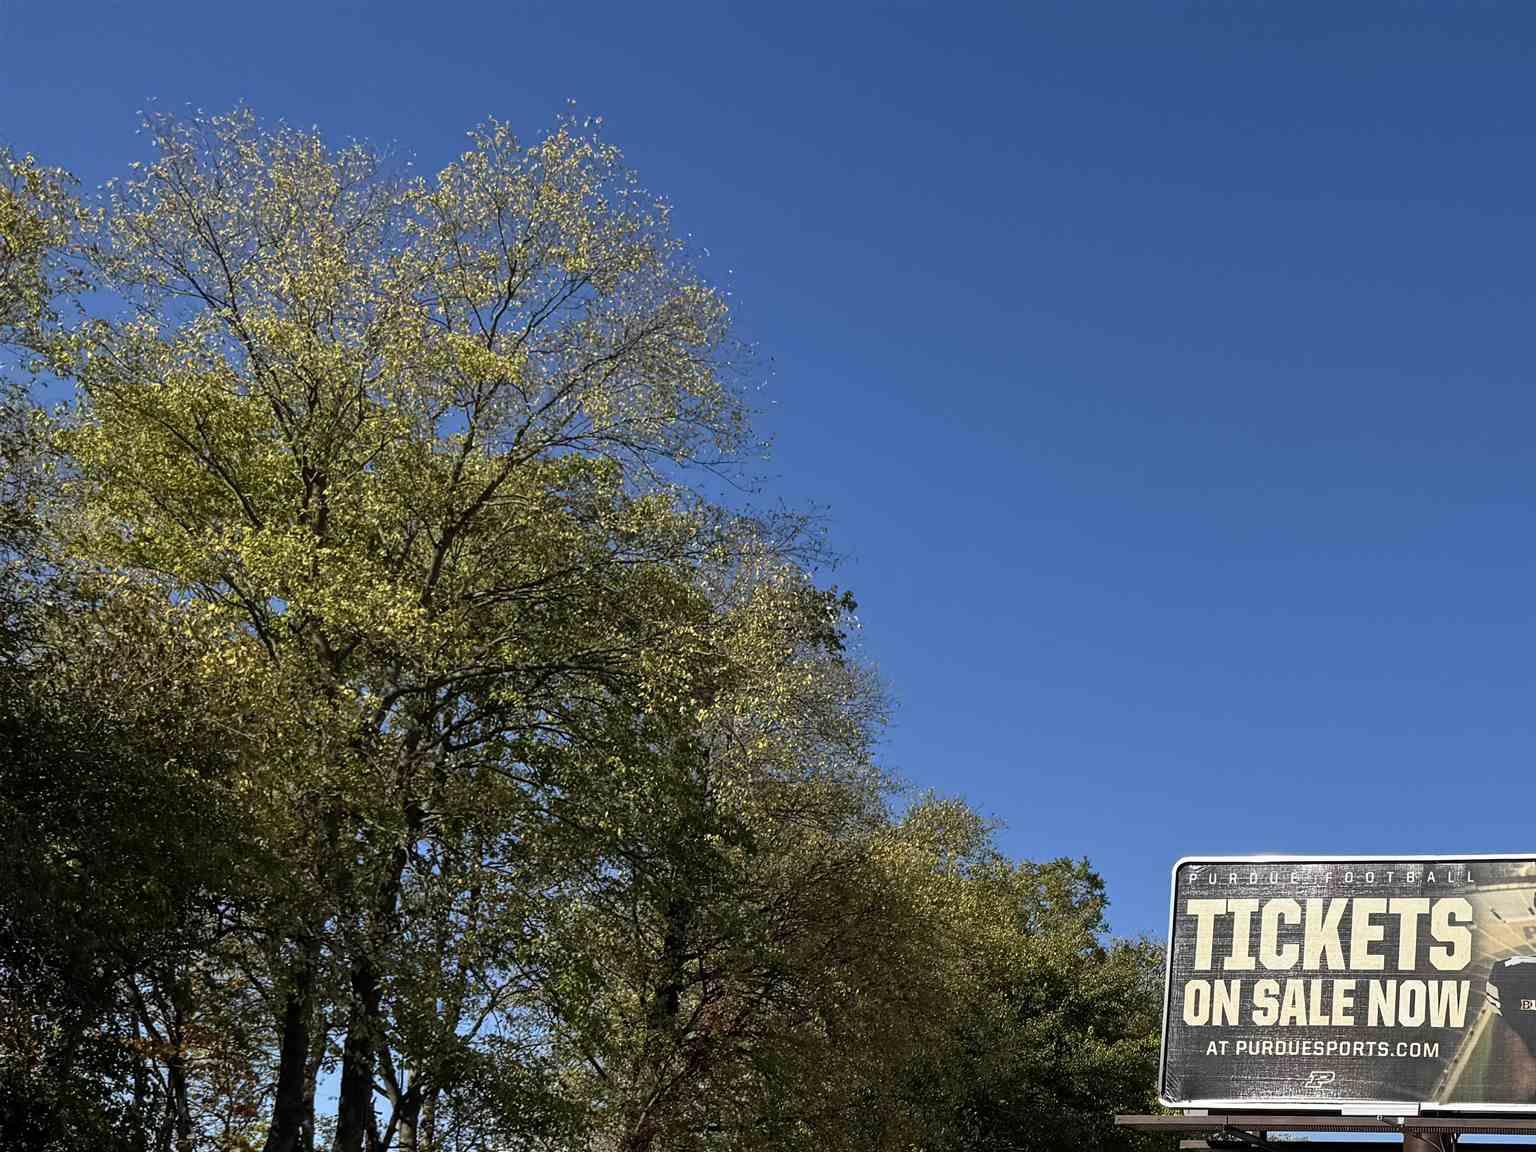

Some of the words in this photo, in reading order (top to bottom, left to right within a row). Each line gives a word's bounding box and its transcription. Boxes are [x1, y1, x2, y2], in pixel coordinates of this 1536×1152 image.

[1189, 871, 1300, 885] PURDUE
[1325, 871, 1475, 884] FOOTBALL
[1187, 897, 1473, 971] TICKETS
[1183, 979, 1241, 1026] ON
[1252, 979, 1356, 1026] SALE
[1368, 980, 1470, 1028] NOW
[1206, 1040, 1230, 1056] AT
[1235, 1040, 1440, 1058] PURDUESPORTS.COM
